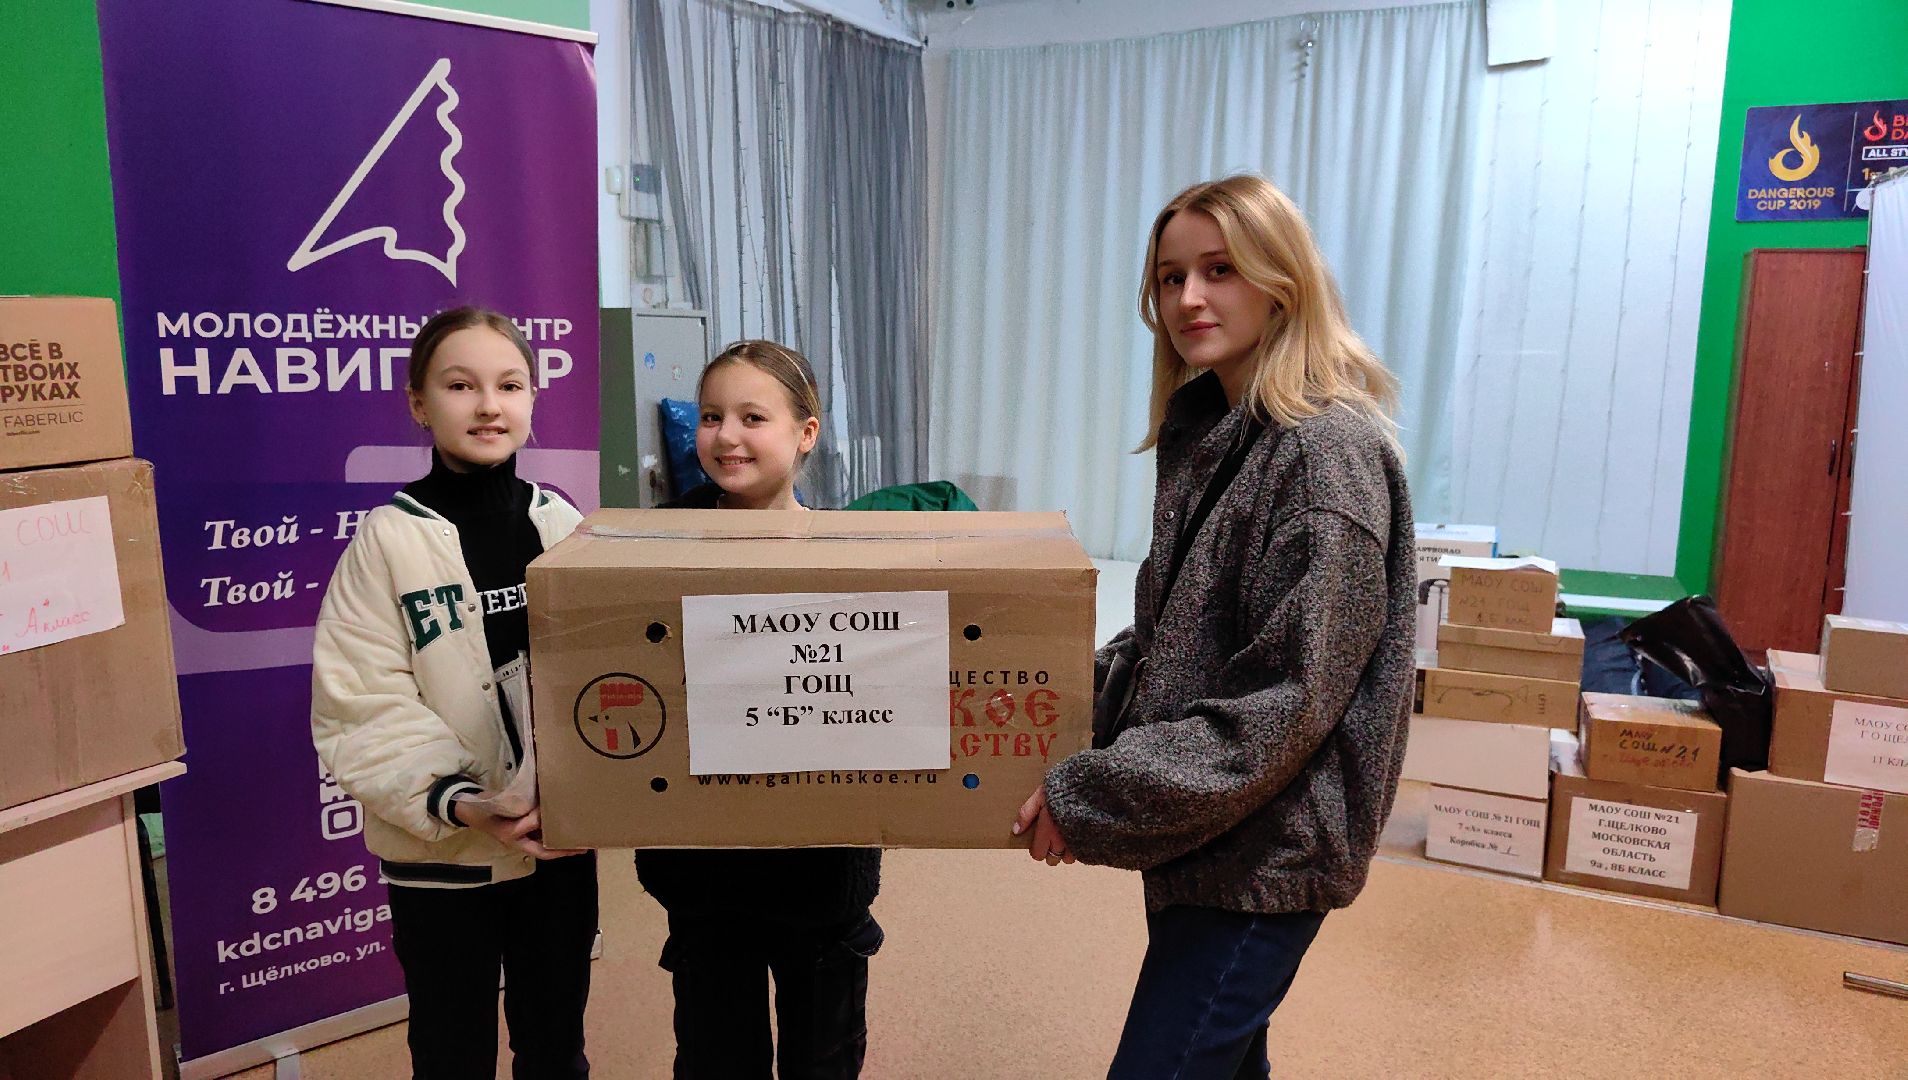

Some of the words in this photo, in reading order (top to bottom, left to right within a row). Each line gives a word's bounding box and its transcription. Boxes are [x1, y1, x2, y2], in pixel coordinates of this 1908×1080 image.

[1868, 148, 1888, 158] ALL
[1747, 187, 1835, 200] DANGEROUS
[1756, 200, 1786, 210] CUP
[1789, 199, 1821, 210] 2019
[157, 307, 434, 343] МОЛОДЁЖНЫ
[48, 342, 63, 359] В
[0, 362, 81, 383] ТВОИХ
[0, 382, 81, 403] РУКАХ
[4, 411, 84, 428] FABERLIC
[204, 515, 300, 550] Твой
[200, 570, 296, 607] Твой
[399, 583, 465, 654] ET
[732, 612, 821, 634] МАОУ
[829, 611, 900, 632] СОШ
[789, 643, 844, 664] №21
[783, 673, 854, 697] ГОЩ
[746, 707, 759, 727] 5
[822, 708, 894, 725] класс
[697, 770, 937, 788] www.galichskoe.ru
[1434, 804, 1462, 815] МАОУ
[1465, 808, 1489, 820] СОШ
[1588, 803, 1621, 815] МАОУ
[1624, 808, 1651, 820] СОШ
[1654, 812, 1680, 824] №21
[1449, 836, 1485, 849] Коробка
[1483, 829, 1513, 838] класса
[1591, 831, 1671, 851] МОСКОВСКАЯ
[1602, 846, 1656, 862] ОБЛАСТЬ
[1627, 865, 1667, 879] КЛАСС
[251, 886, 278, 915] 8
[290, 864, 367, 903] 496
[219, 981, 235, 995] г.
[241, 951, 351, 989] Щёлково,
[355, 940, 387, 961] ул.
